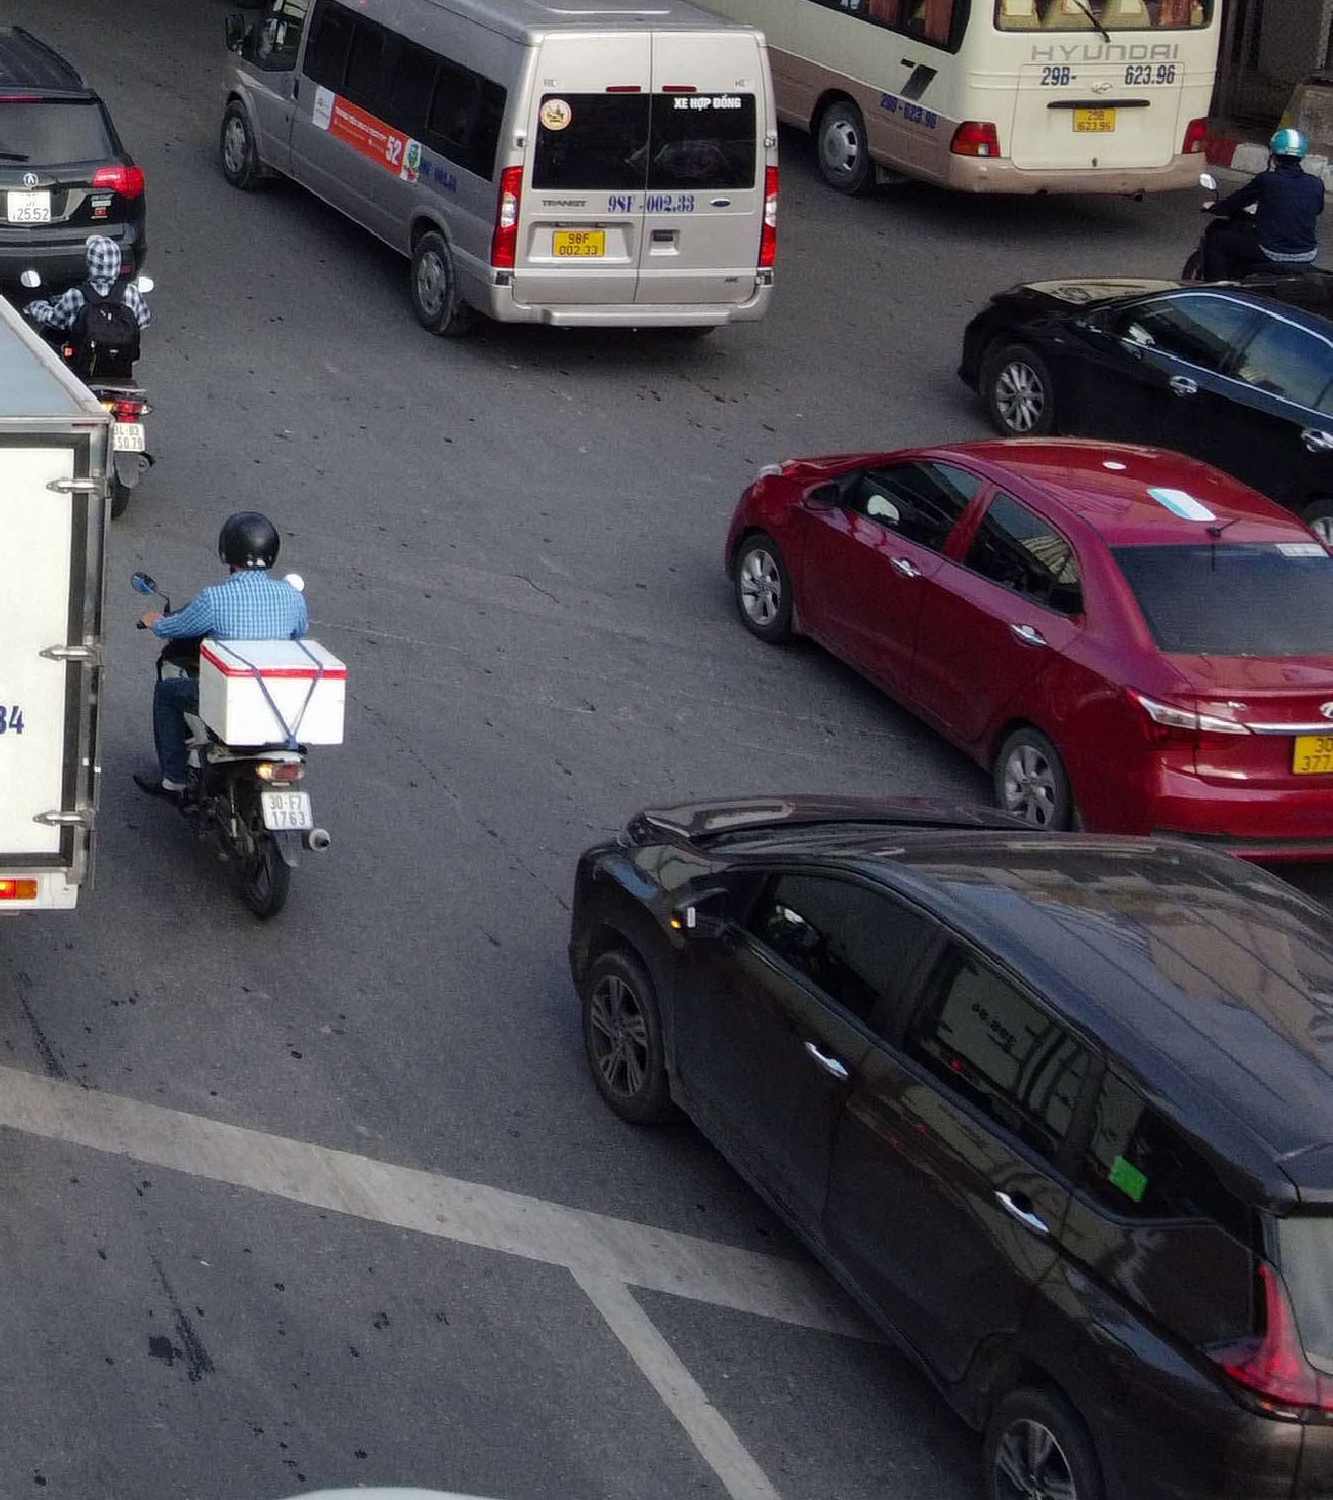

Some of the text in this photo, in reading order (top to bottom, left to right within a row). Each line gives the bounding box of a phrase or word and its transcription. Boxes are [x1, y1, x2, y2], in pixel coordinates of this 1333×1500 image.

[1124, 64, 1176, 85] 623.96
[674, 94, 742, 111] XE HỢP ĐỒNG
[385, 135, 403, 167] 52
[568, 233, 590, 244] 98F
